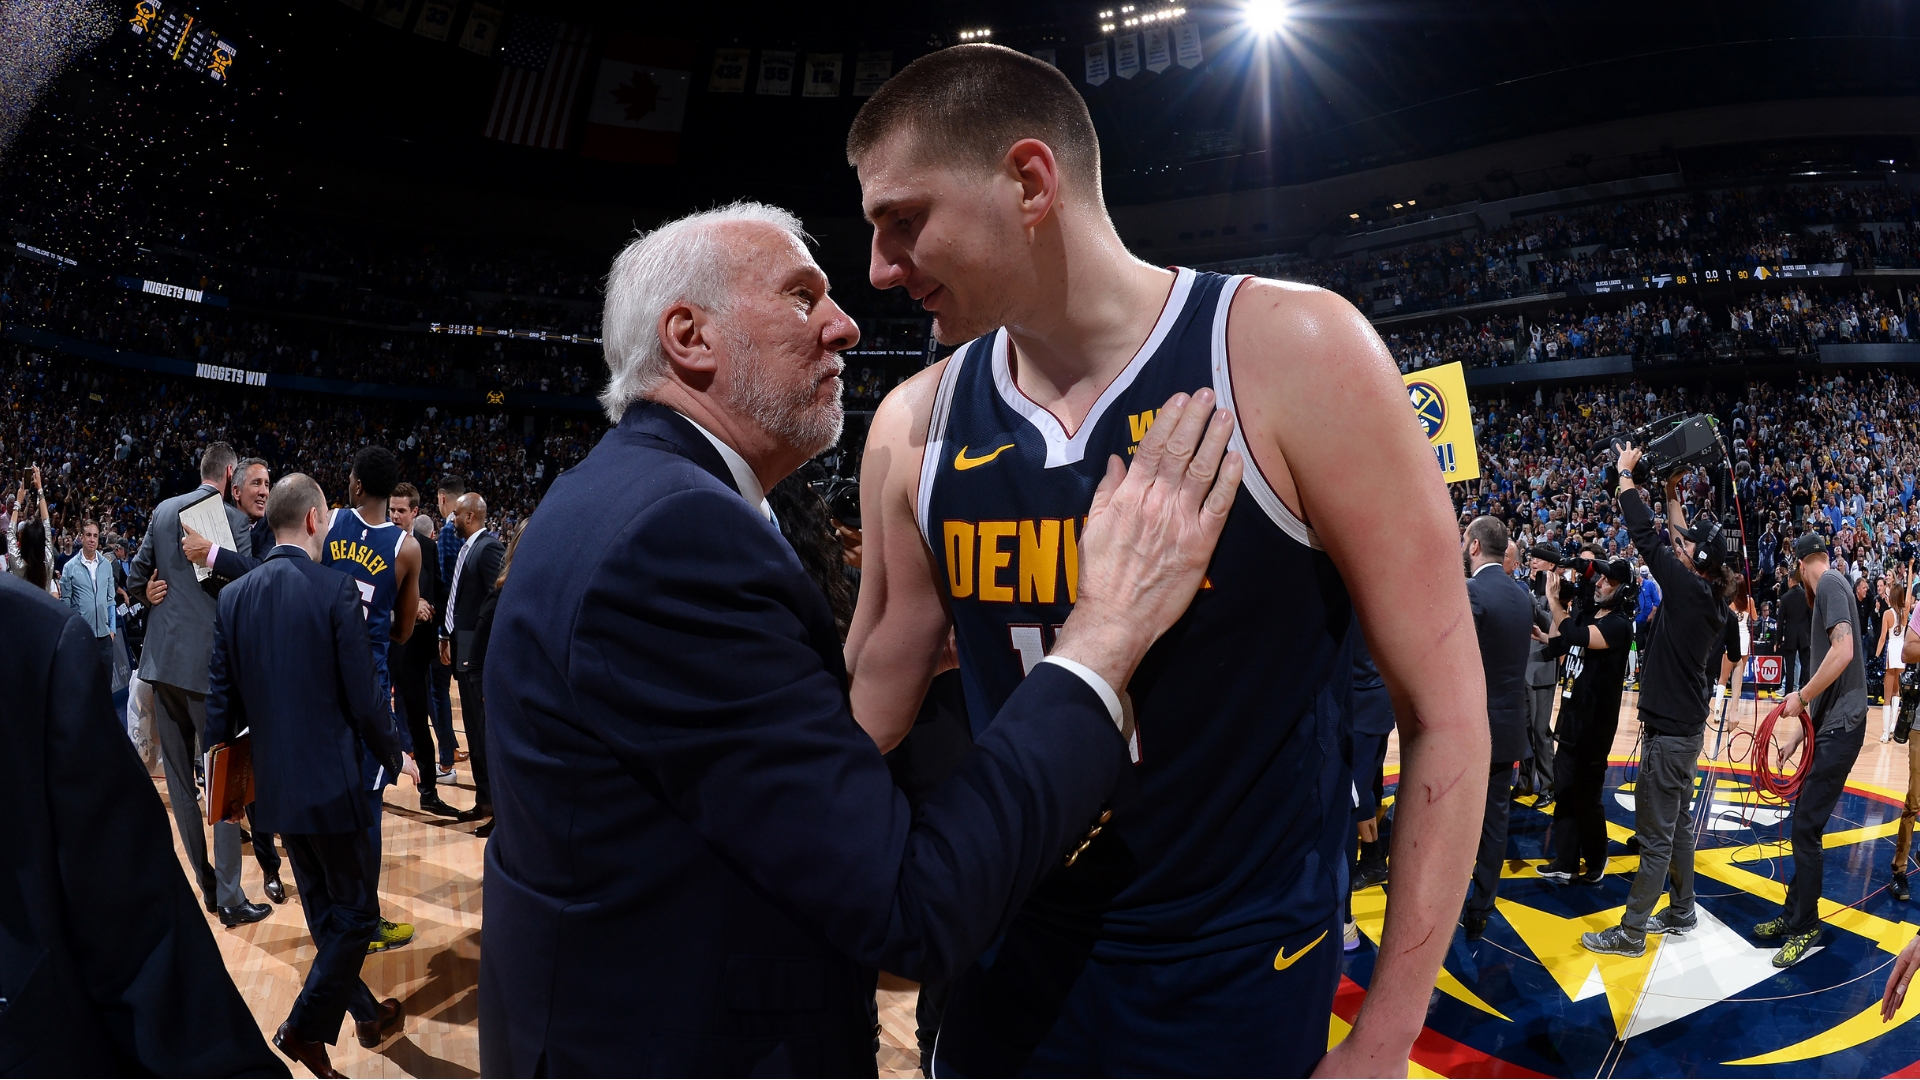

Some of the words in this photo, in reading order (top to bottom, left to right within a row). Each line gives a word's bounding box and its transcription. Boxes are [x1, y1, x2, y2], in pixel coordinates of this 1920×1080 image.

[425, 7, 449, 26] 33
[473, 23, 488, 39] 2
[715, 65, 743, 79] 432
[763, 67, 790, 81] 55
[812, 69, 835, 83] 12
[1676, 275, 1687, 284] 86
[1705, 269, 1719, 279] 0.0
[1738, 270, 1749, 279] 90
[142, 280, 185, 300] NUGGETS
[184, 288, 204, 303] WIN
[195, 363, 245, 383] NUGGETS
[245, 371, 267, 387] WIN
[329, 539, 388, 576] BEASLEY
[1761, 666, 1779, 675] TNT
